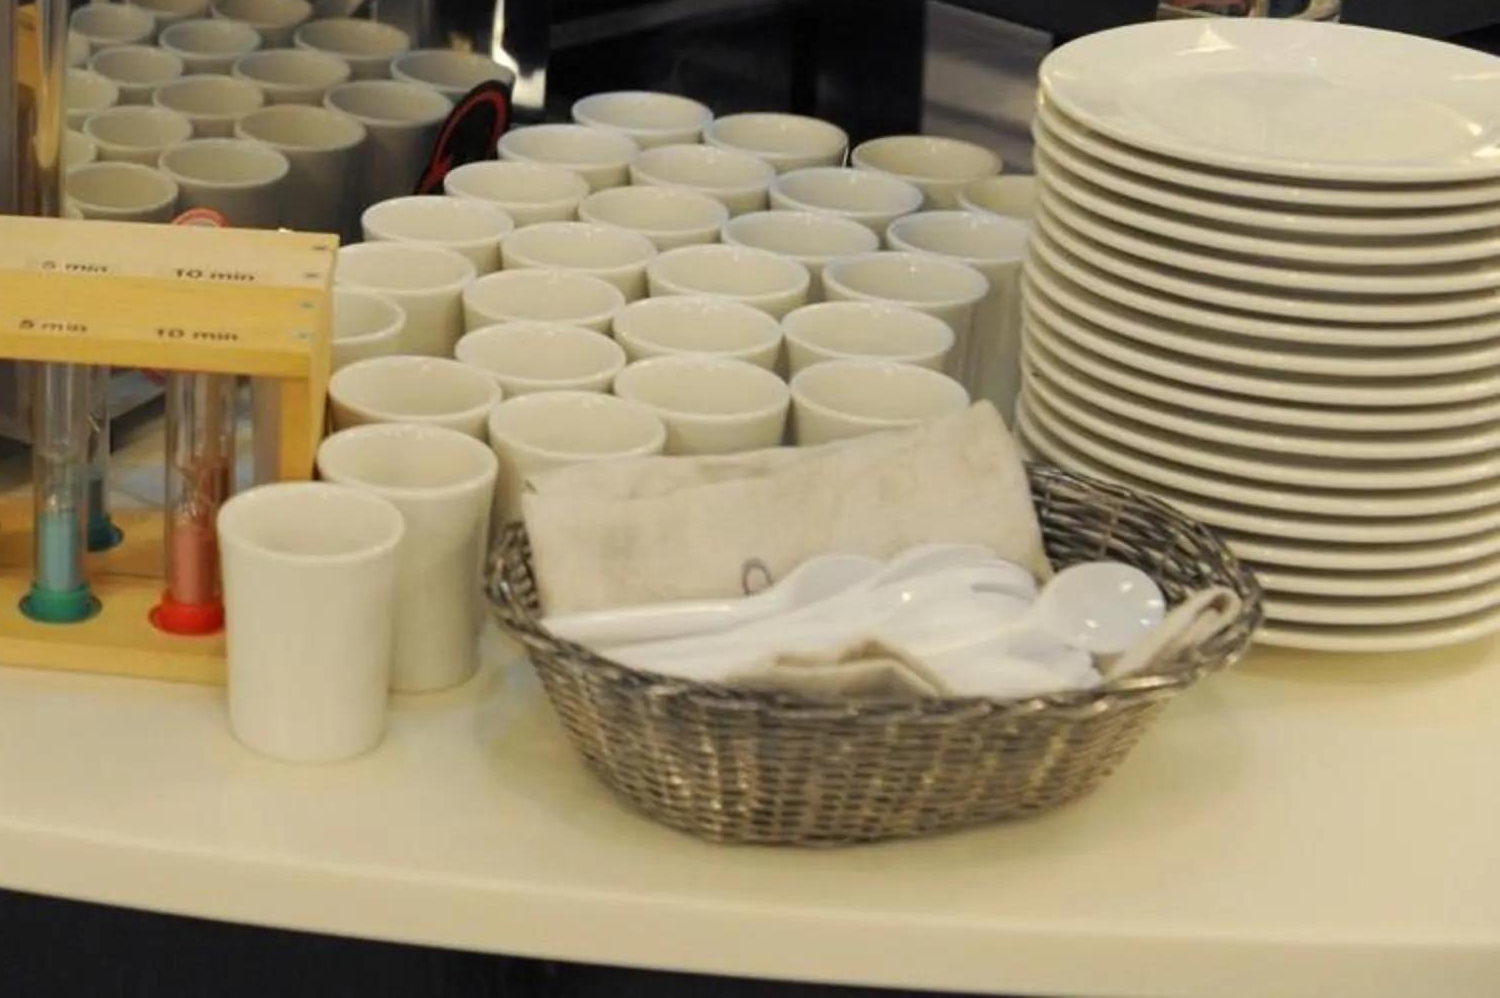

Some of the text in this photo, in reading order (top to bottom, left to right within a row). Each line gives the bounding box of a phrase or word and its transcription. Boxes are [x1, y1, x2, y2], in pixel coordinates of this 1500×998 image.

[63, 262, 108, 274] min
[209, 270, 256, 282] min
[41, 322, 89, 333] min
[191, 328, 239, 342] min
